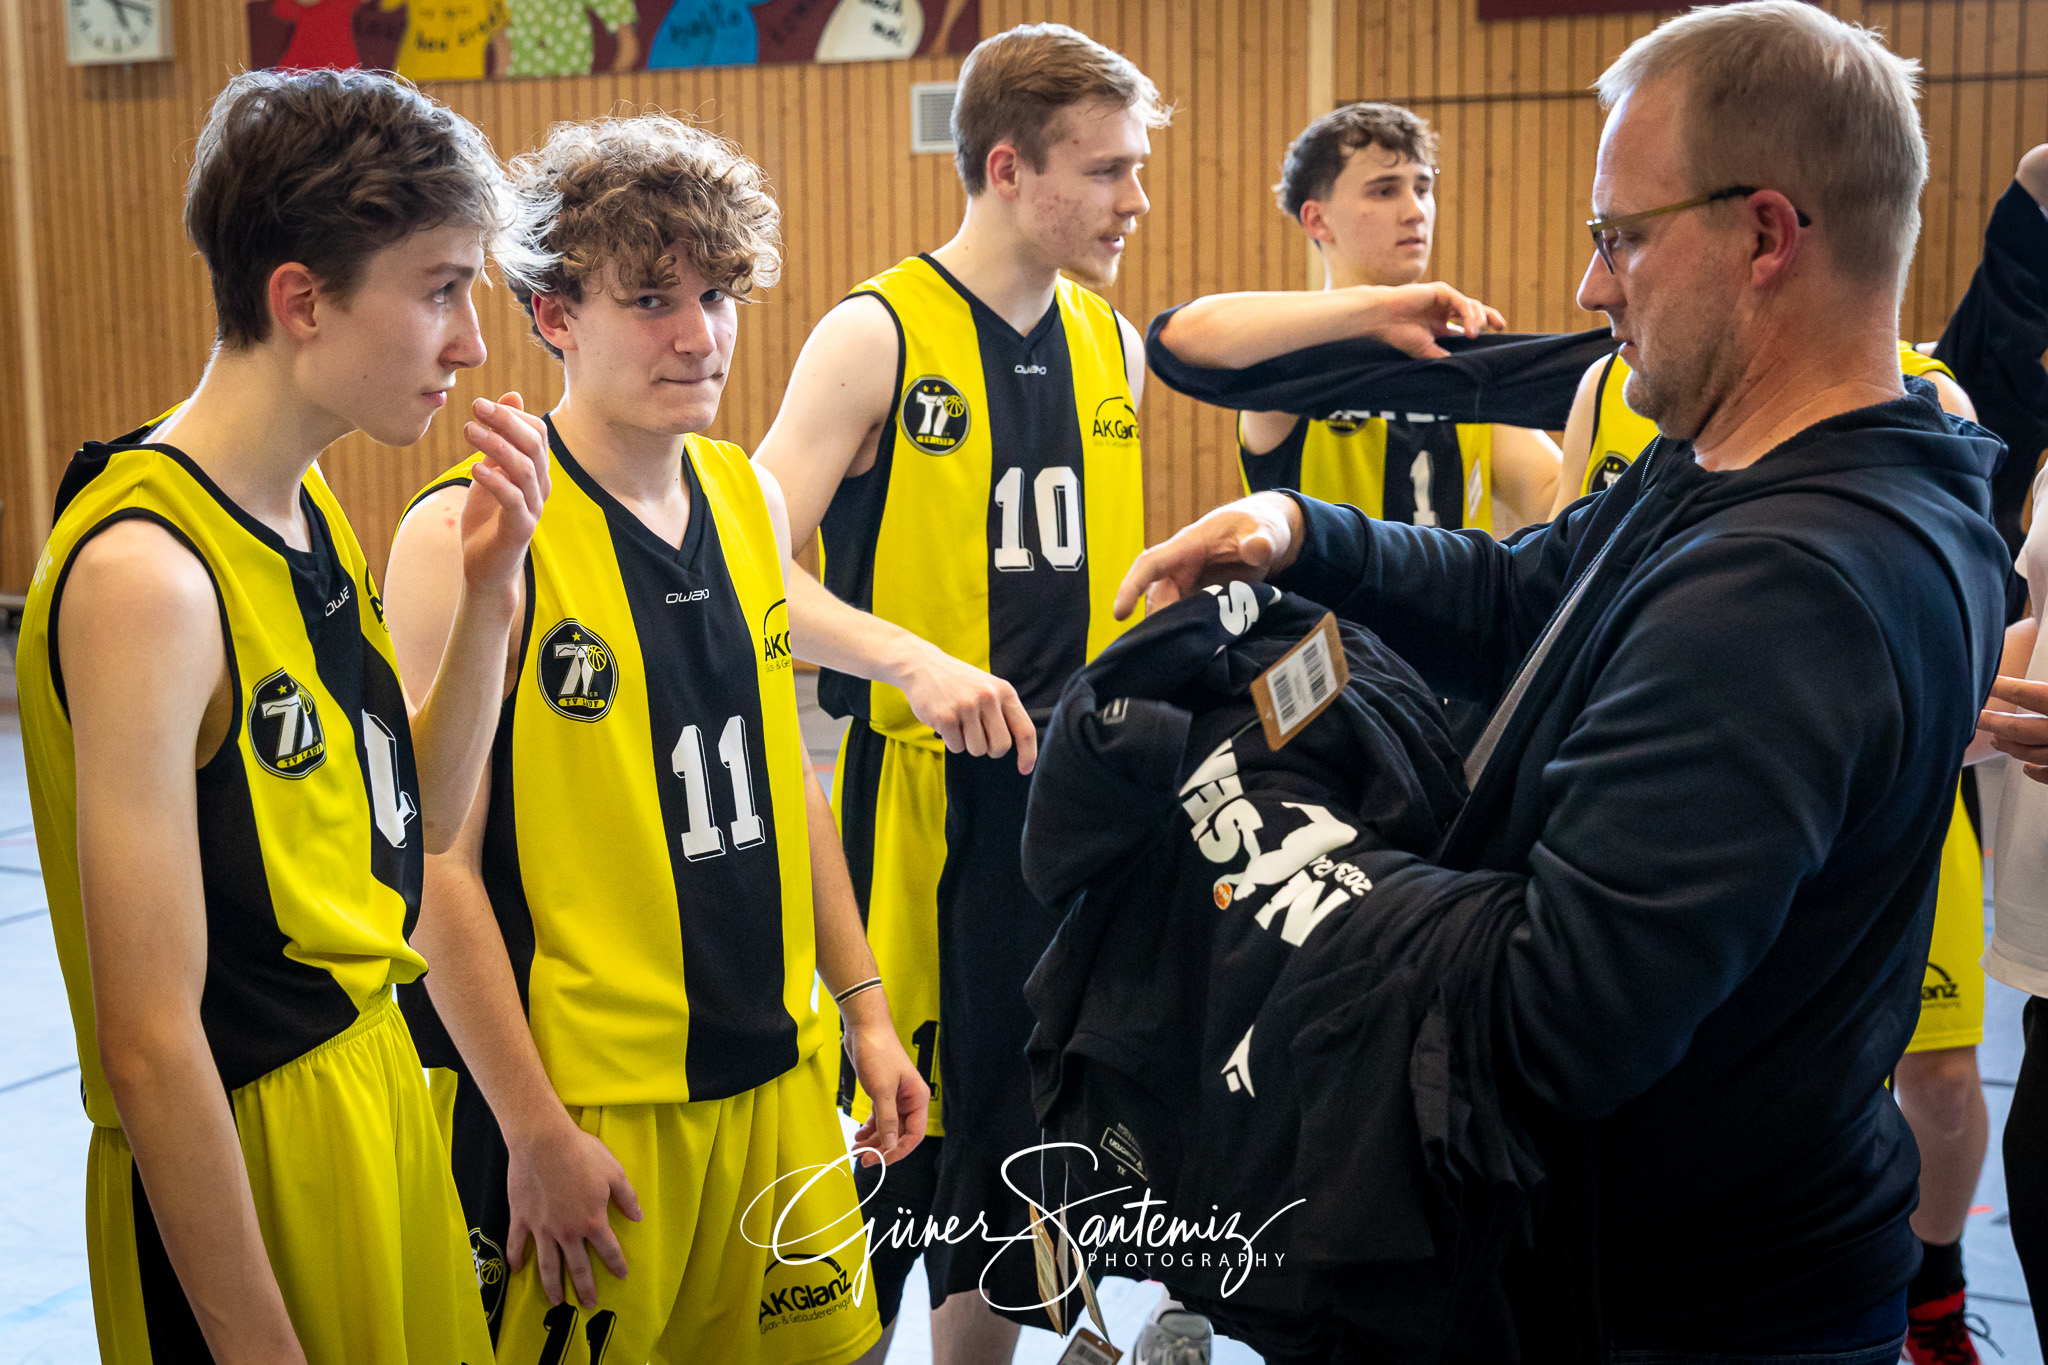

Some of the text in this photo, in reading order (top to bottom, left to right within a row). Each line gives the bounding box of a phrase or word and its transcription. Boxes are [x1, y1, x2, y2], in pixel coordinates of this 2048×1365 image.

[994, 466, 1085, 572] 10
[284, 757, 298, 767] TV
[671, 715, 765, 862] 11
